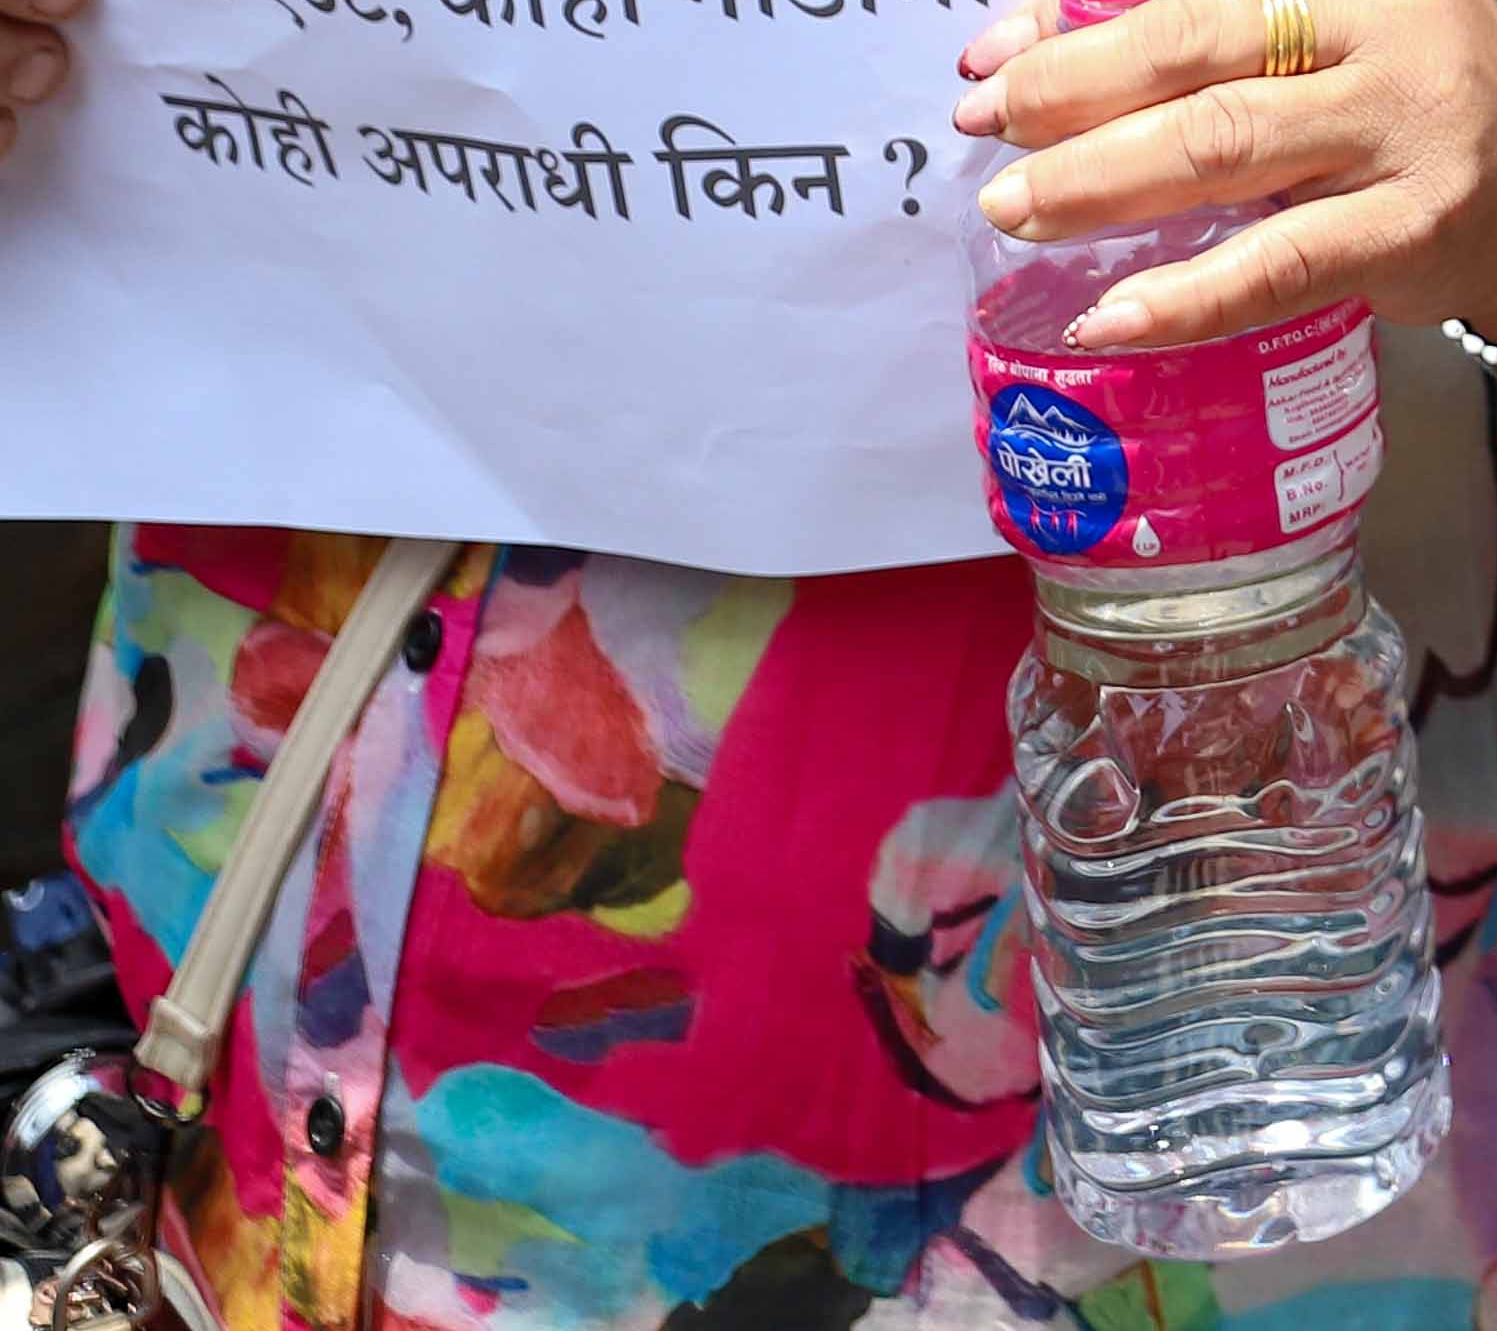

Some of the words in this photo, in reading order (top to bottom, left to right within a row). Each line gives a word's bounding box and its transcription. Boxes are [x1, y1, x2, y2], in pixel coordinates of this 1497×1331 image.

[158, 71, 342, 189] कोही
[356, 122, 635, 222] अपराधी
[652, 113, 853, 222] किन
[882, 136, 930, 218] ?
